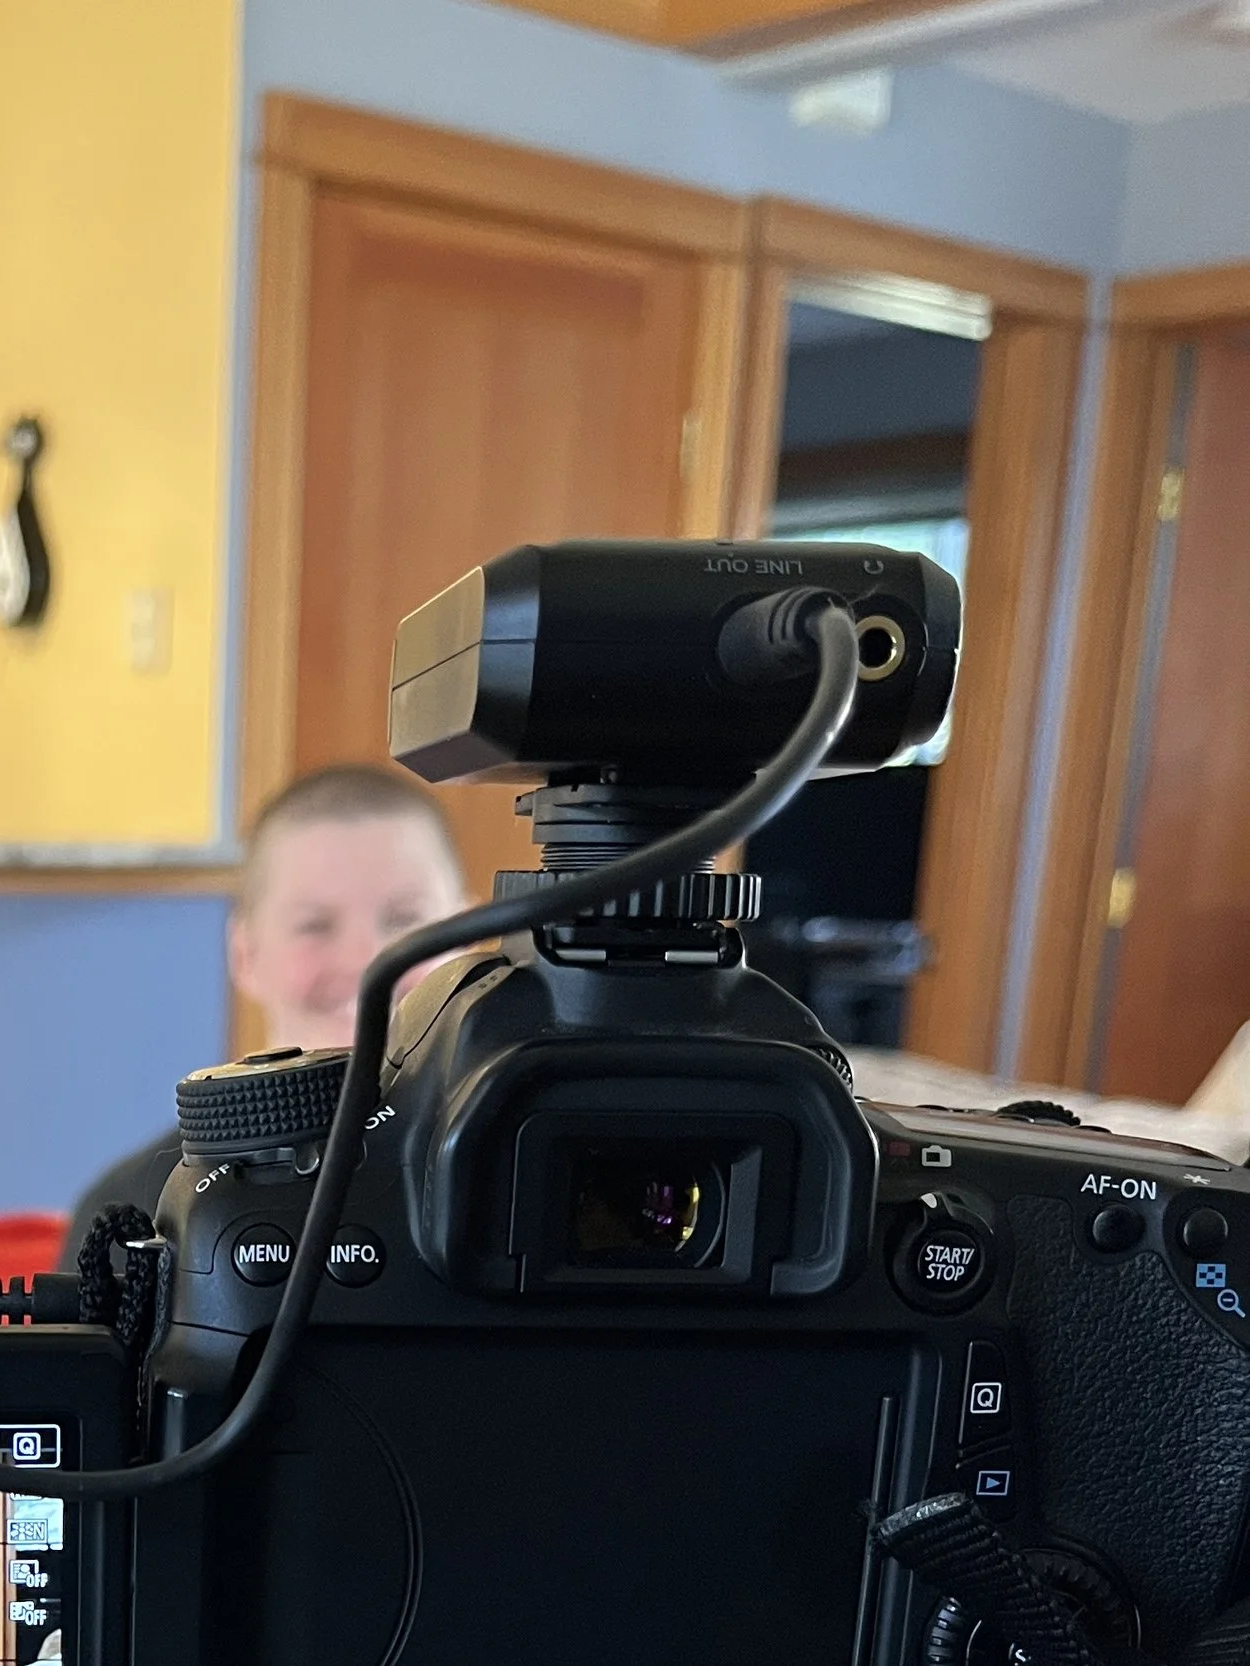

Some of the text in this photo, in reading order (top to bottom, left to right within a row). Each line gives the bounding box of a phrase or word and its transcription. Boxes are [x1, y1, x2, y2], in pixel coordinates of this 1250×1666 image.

[704, 557, 803, 575] LINE OUT
[364, 1105, 396, 1130] ON
[195, 1163, 231, 1193] OFF
[1080, 1173, 1157, 1200] AF-ON
[238, 1245, 290, 1263] MENU
[330, 1244, 379, 1264] INFO.
[925, 1245, 975, 1265] START/
[926, 1264, 965, 1281] STOP
[977, 1389, 995, 1407] Q
[18, 1438, 35, 1455] Q
[26, 1573, 48, 1588] OFF
[25, 1610, 47, 1625] OFF
